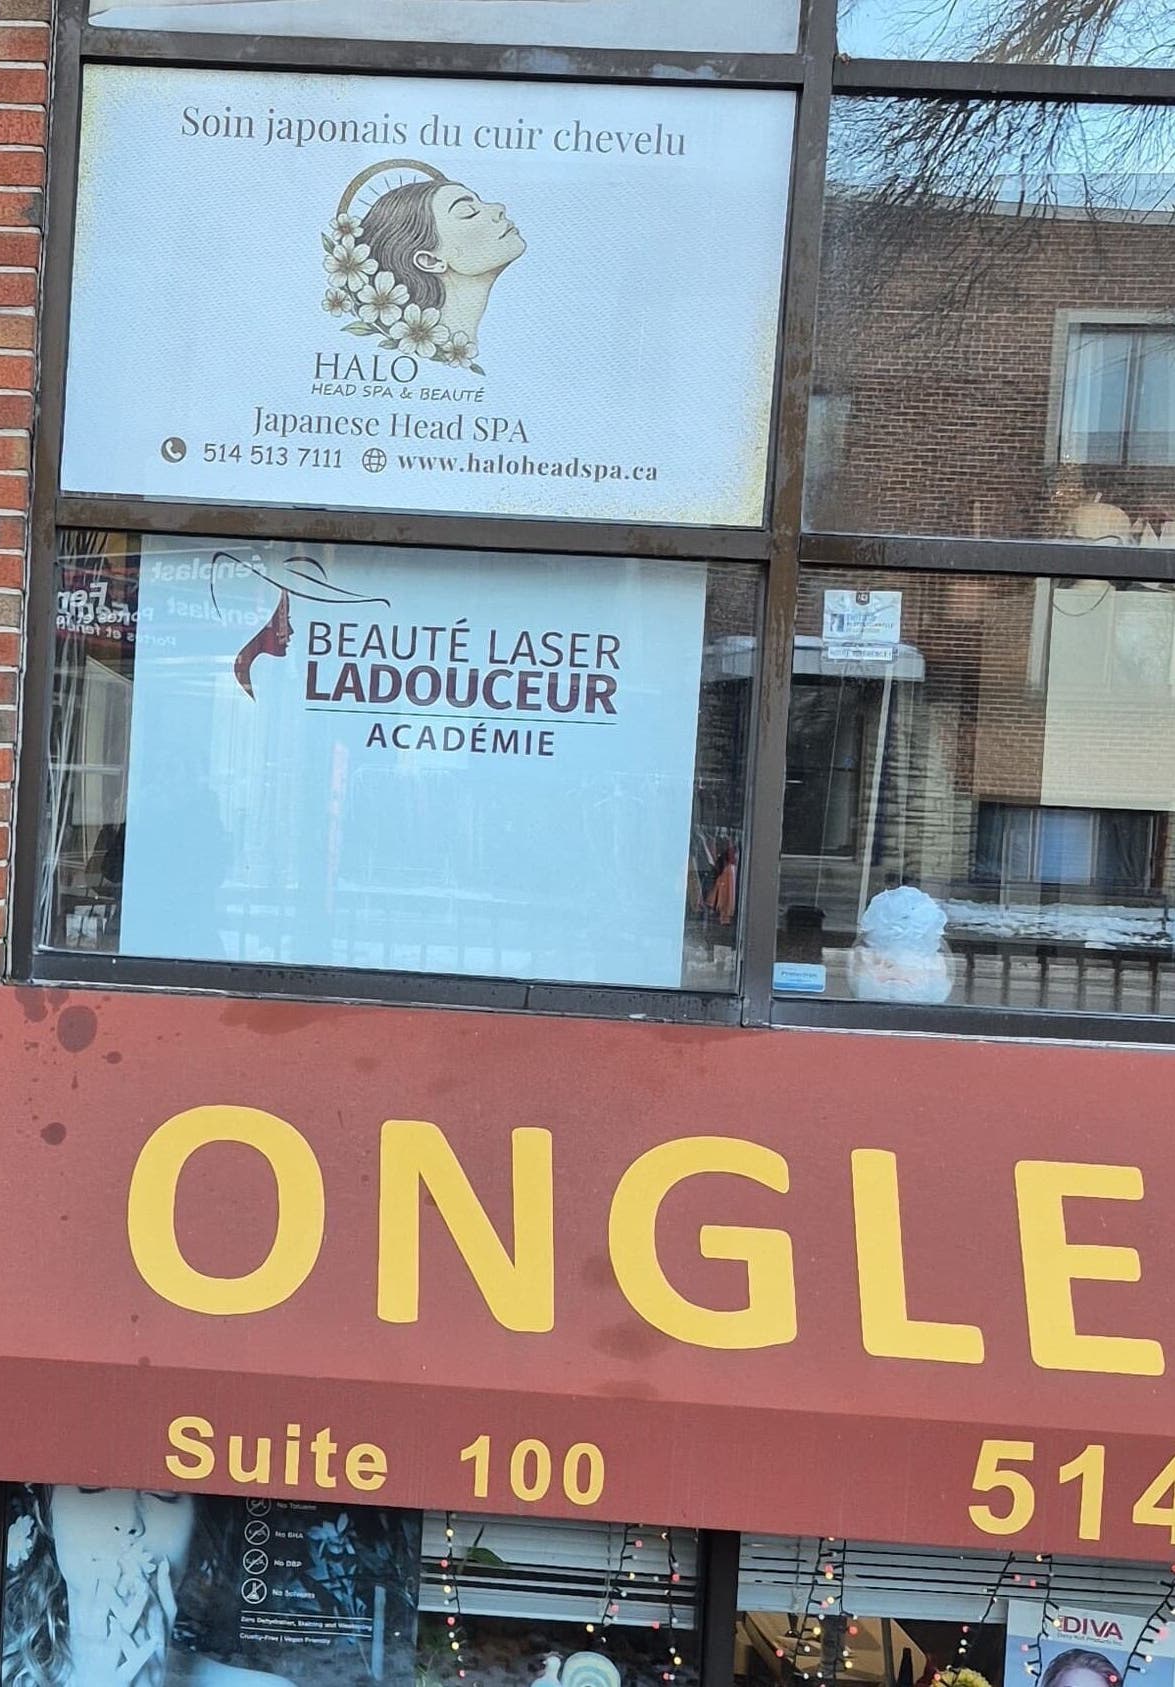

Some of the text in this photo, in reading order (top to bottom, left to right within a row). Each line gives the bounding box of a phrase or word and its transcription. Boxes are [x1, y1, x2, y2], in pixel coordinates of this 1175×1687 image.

[181, 106, 686, 156] Soin japonais du cuir chevelu
[314, 352, 419, 383] HALO
[311, 383, 485, 403] HEAD SPA & BEAUTÉ
[252, 406, 530, 444] Japanese Head SPA
[203, 443, 658, 483] 514 513 7111 www.haloheadspa.ca
[308, 618, 621, 670] BEAUTÉ LASER
[305, 661, 618, 714] LADOUCEUR
[365, 722, 555, 757] ACADÉMIE
[127, 1104, 1166, 1376] ONGLE
[165, 1416, 1175, 1546] Suite 100 514
[1060, 1615, 1123, 1641] DIVA
